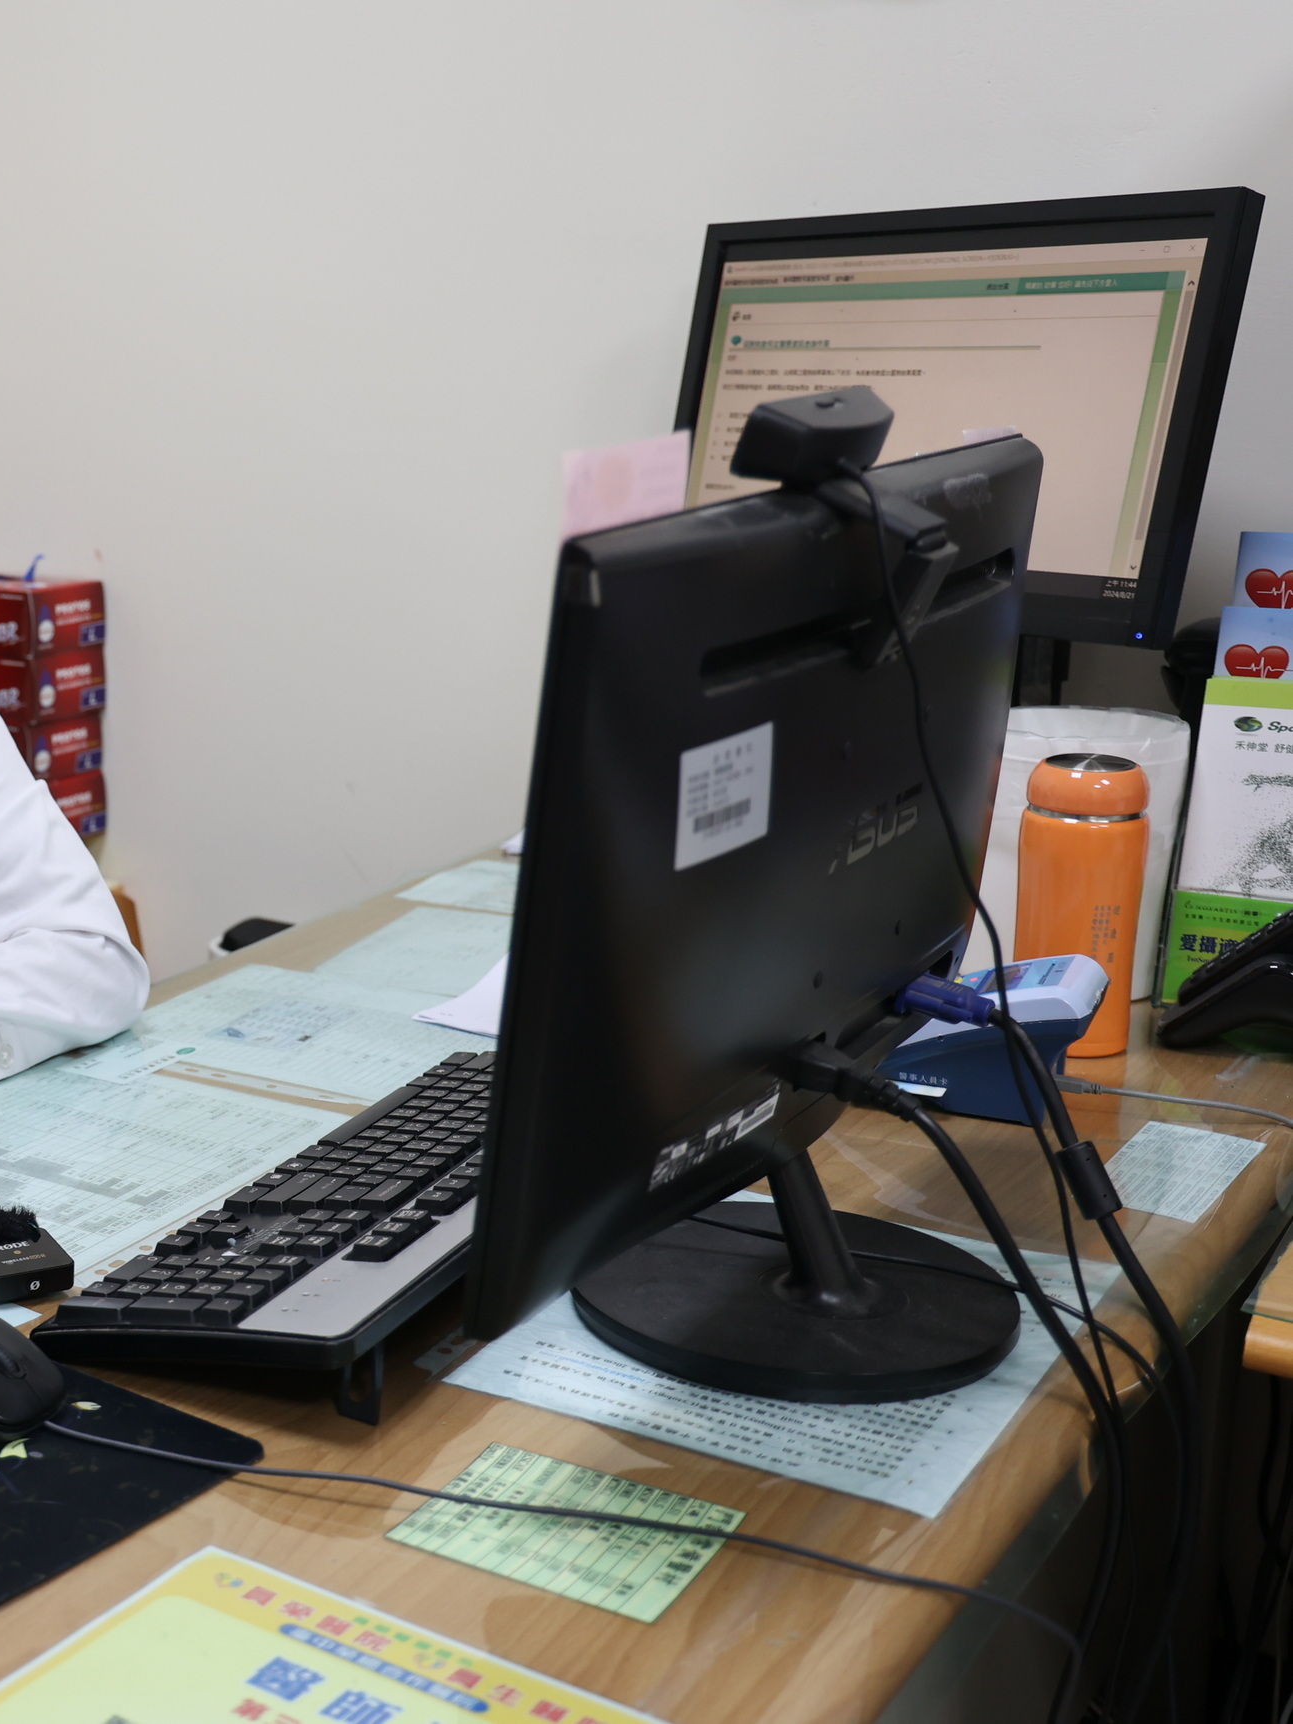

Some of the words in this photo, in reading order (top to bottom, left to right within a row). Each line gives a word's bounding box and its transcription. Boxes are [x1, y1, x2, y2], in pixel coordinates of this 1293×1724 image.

[1102, 590, 1135, 599] 2024/8/21
[1235, 740, 1268, 752] 禾伸堂
[899, 1072, 948, 1085] 醫事人員卡
